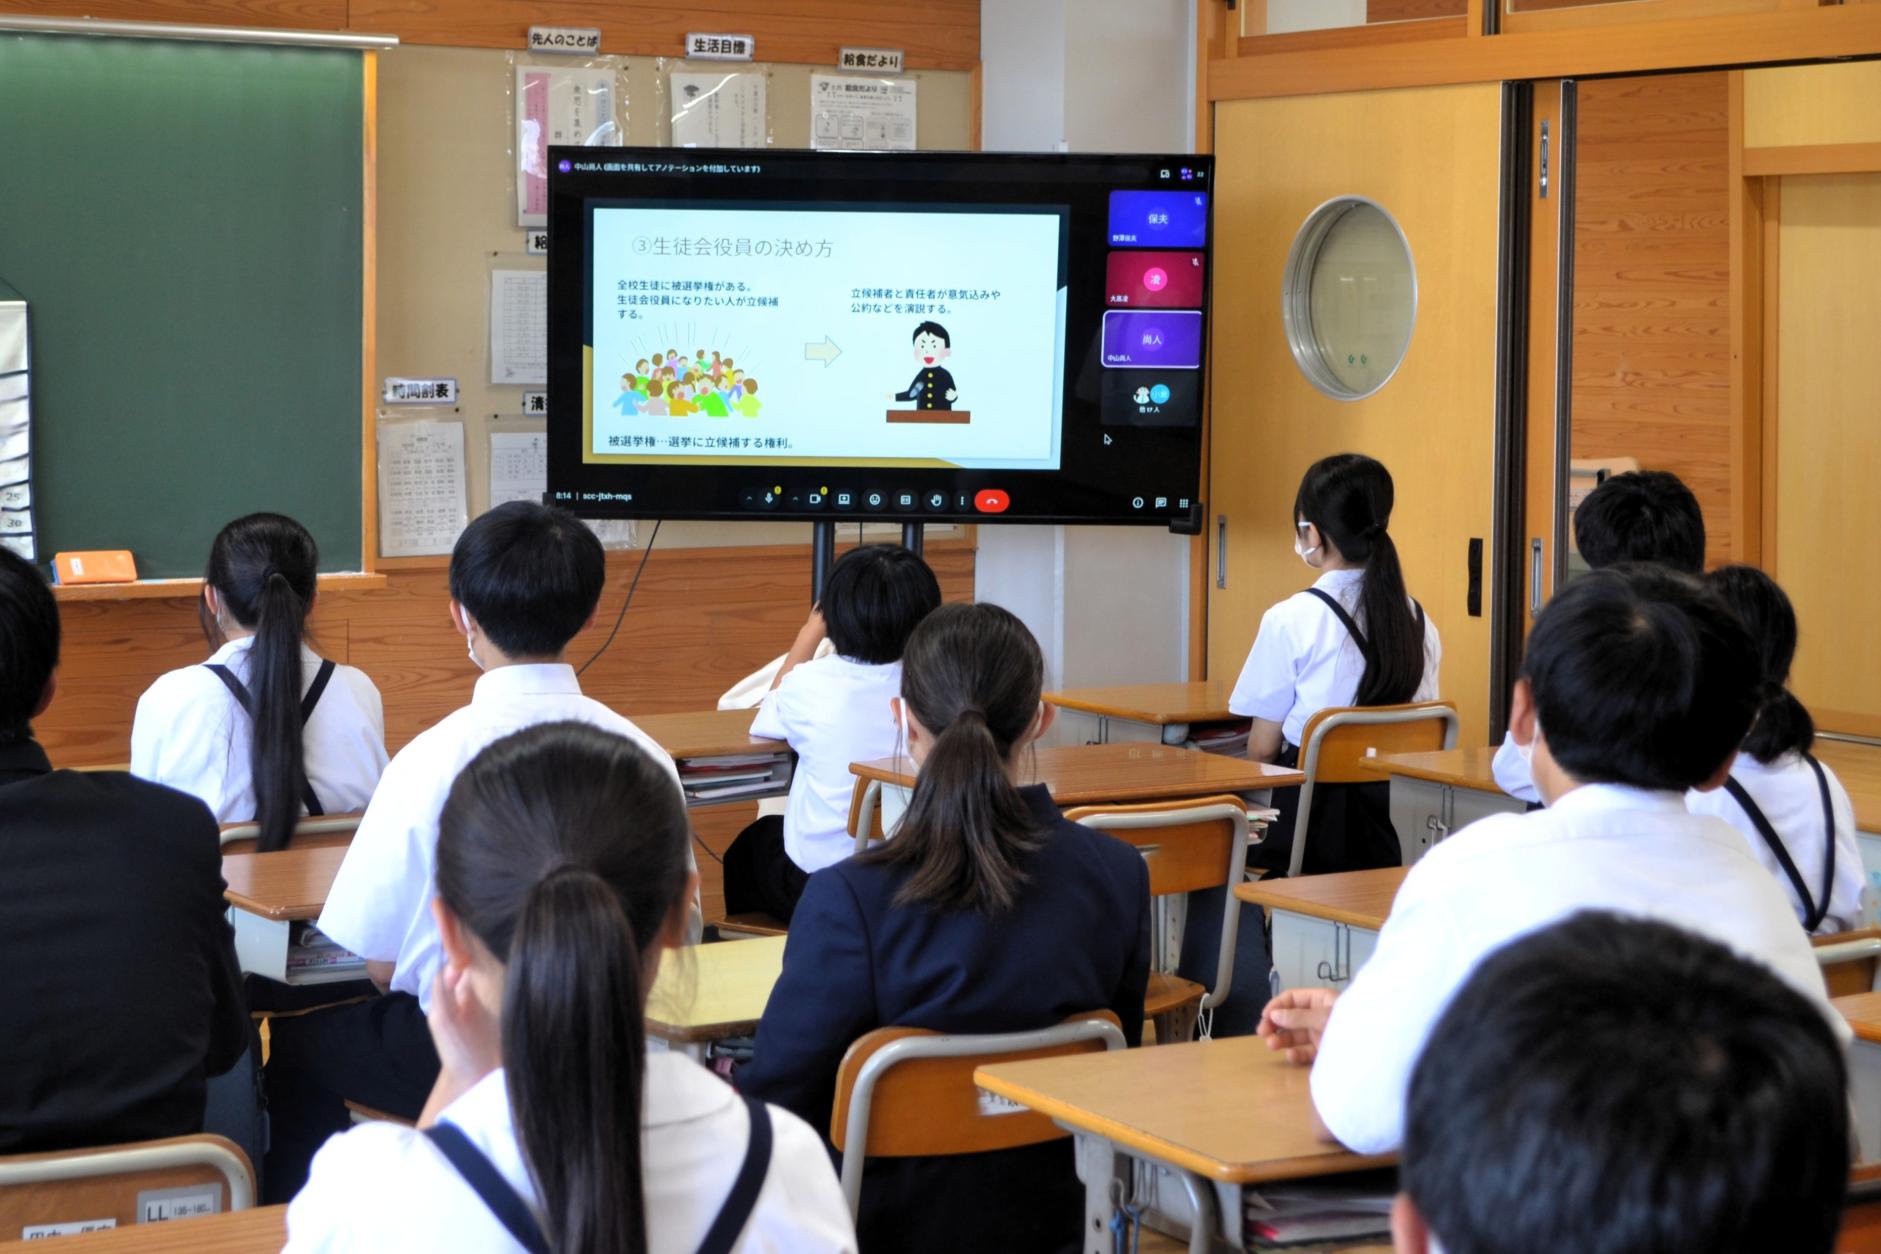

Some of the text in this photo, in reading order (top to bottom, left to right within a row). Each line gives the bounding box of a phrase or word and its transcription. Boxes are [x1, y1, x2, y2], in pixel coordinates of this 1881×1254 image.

[532, 33, 598, 47] 先人のことば
[694, 37, 746, 55] 生活目標
[844, 53, 898, 68] 給食だより
[1148, 213, 1169, 224] 保夫
[632, 236, 833, 258] ③生徒会役員の決め方
[617, 280, 751, 292] 全校生徒に被選挙権がある。
[850, 288, 1001, 300] 立候補者と責任者が意気込みや
[617, 294, 779, 307] 生徒会役員になりたい人が立候補
[618, 309, 643, 319] する。
[850, 303, 951, 314] 公約などを演説する。
[1142, 334, 1162, 345] 尚人
[1107, 354, 1132, 362] 中山尚人
[392, 383, 449, 398] 時間割表
[531, 396, 547, 411] 清
[608, 435, 793, 449] 被選挙権…選挙に立候補する権利。
[6, 492, 21, 501] 25
[7, 519, 22, 528] 30
[148, 1205, 169, 1222] LL
